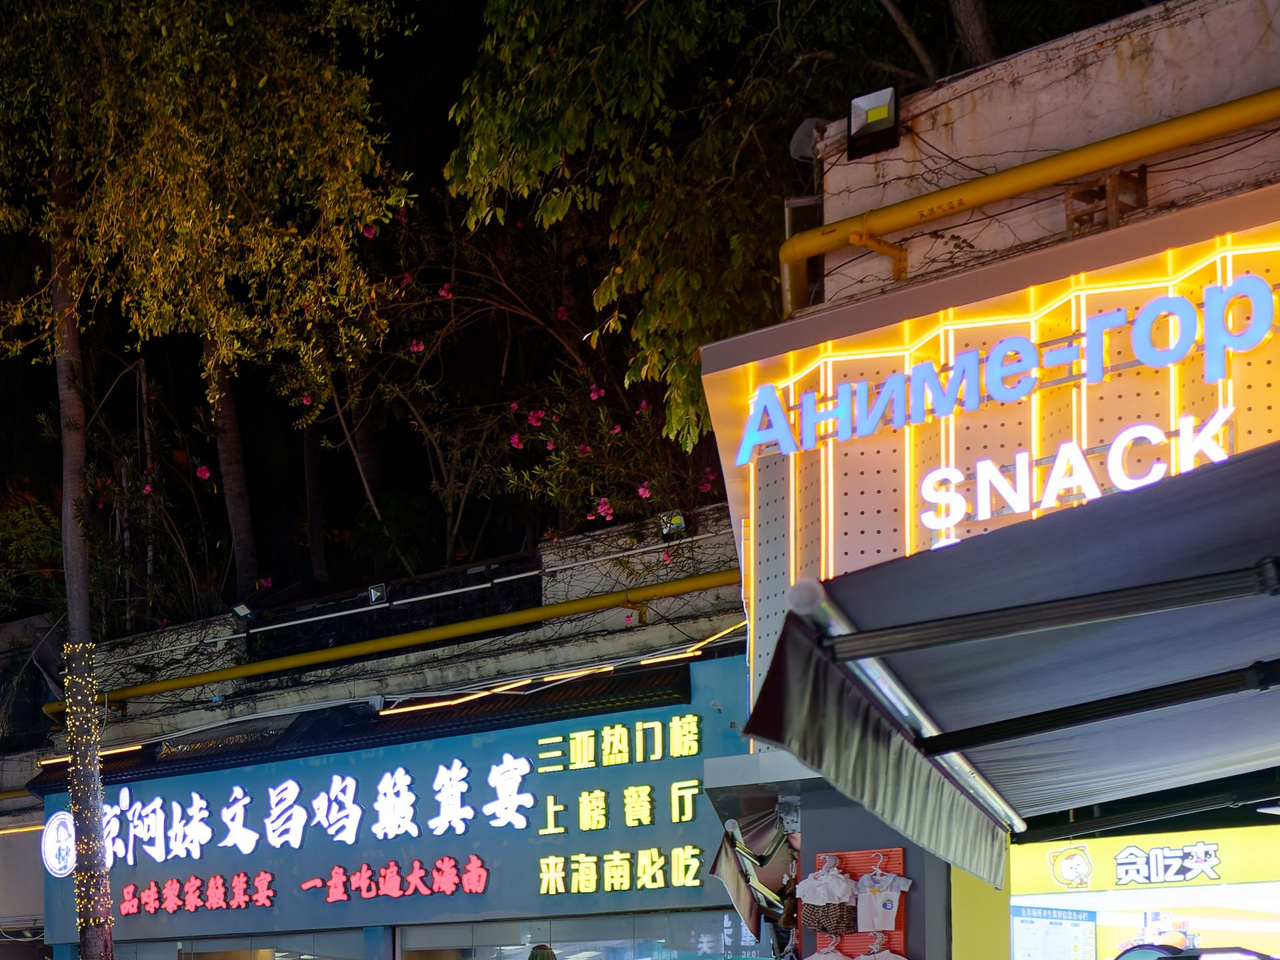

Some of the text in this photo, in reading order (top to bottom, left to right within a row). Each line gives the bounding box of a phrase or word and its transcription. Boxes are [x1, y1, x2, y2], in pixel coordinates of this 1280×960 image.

[735, 275, 1275, 466] Аниме-гор
[920, 406, 1238, 531] SNACK
[537, 714, 699, 773] 三亚热门榜
[538, 779, 700, 836] 上榜餐厅
[300, 854, 489, 903] 一盘吃遍大海南
[539, 845, 701, 895] 来海南必吃
